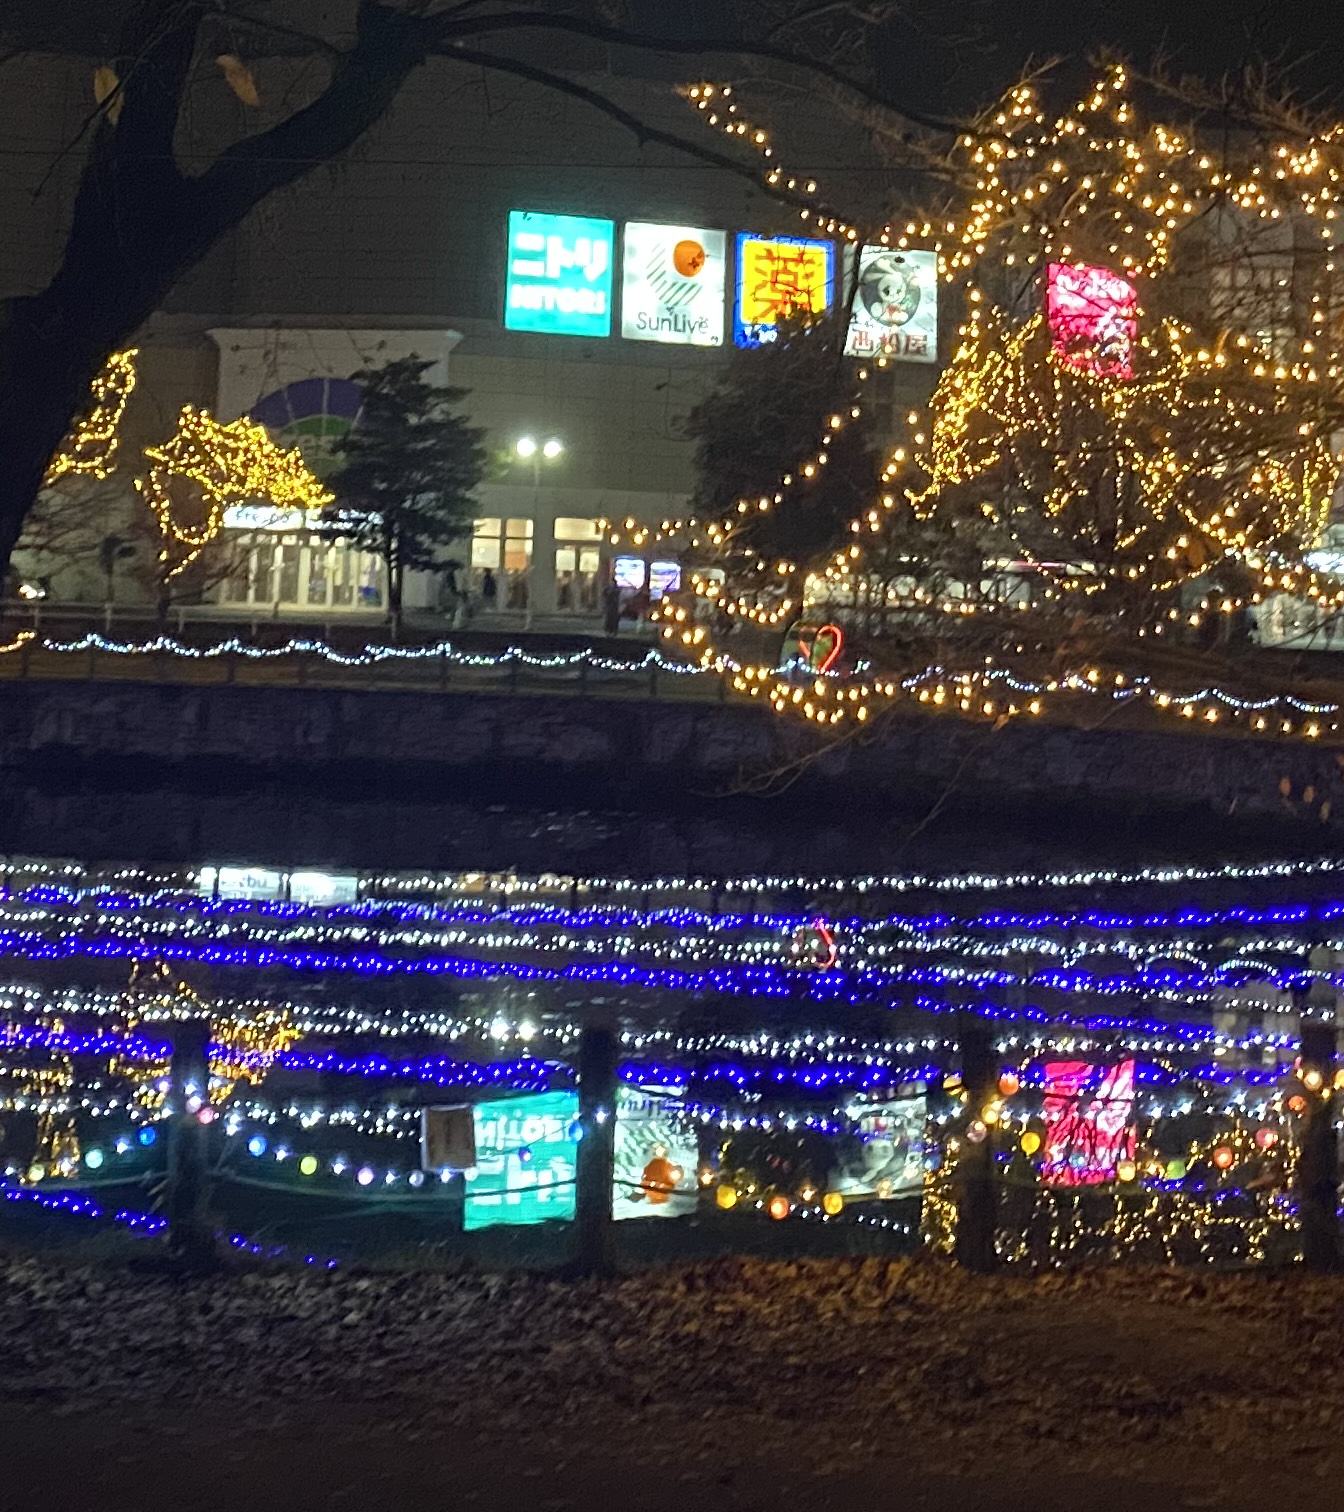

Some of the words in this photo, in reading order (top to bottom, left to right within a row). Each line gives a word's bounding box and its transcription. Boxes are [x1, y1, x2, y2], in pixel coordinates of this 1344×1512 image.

[512, 232, 608, 282] ニトリ
[636, 311, 709, 334] SunLive
